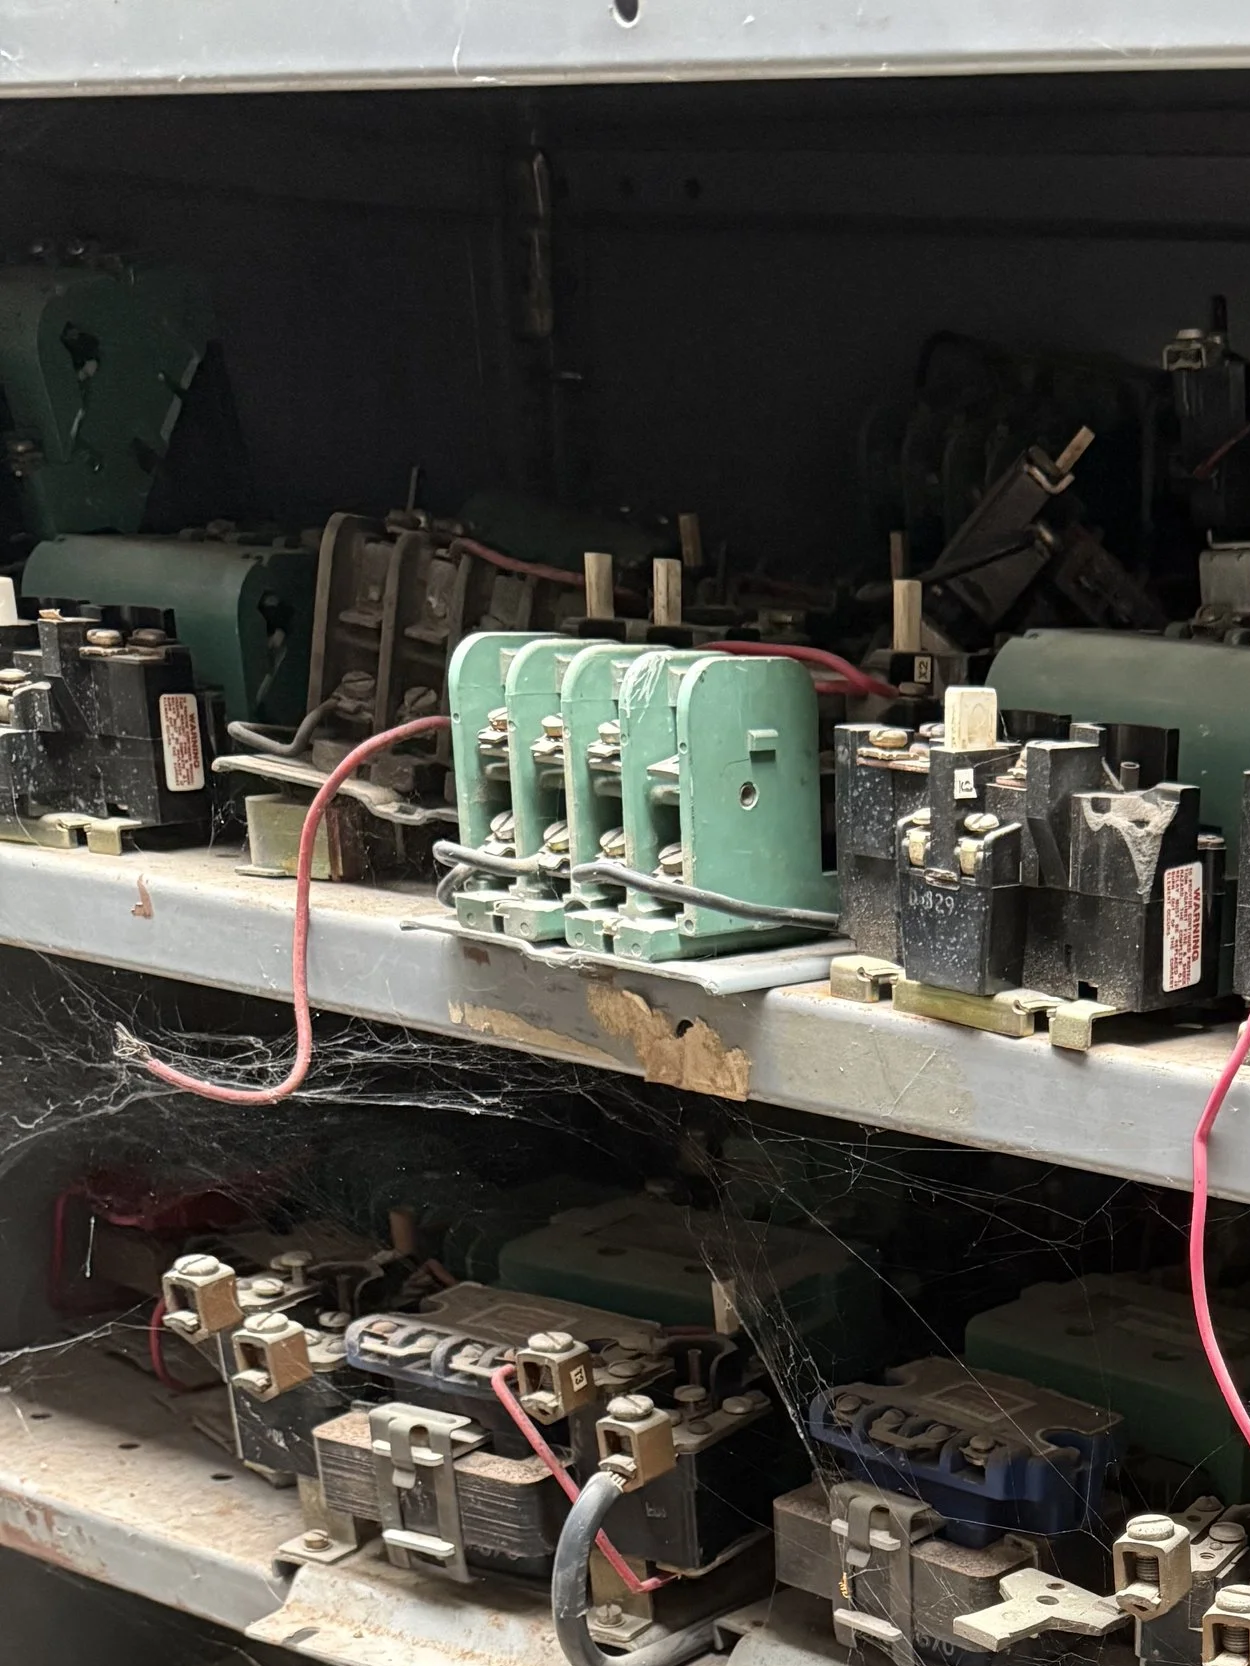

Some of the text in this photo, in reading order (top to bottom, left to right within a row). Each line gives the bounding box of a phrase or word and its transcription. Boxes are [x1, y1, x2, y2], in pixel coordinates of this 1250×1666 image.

[189, 713, 200, 769] WARNING
[1192, 887, 1200, 962] WARNING
[574, 1368, 583, 1385] T3
